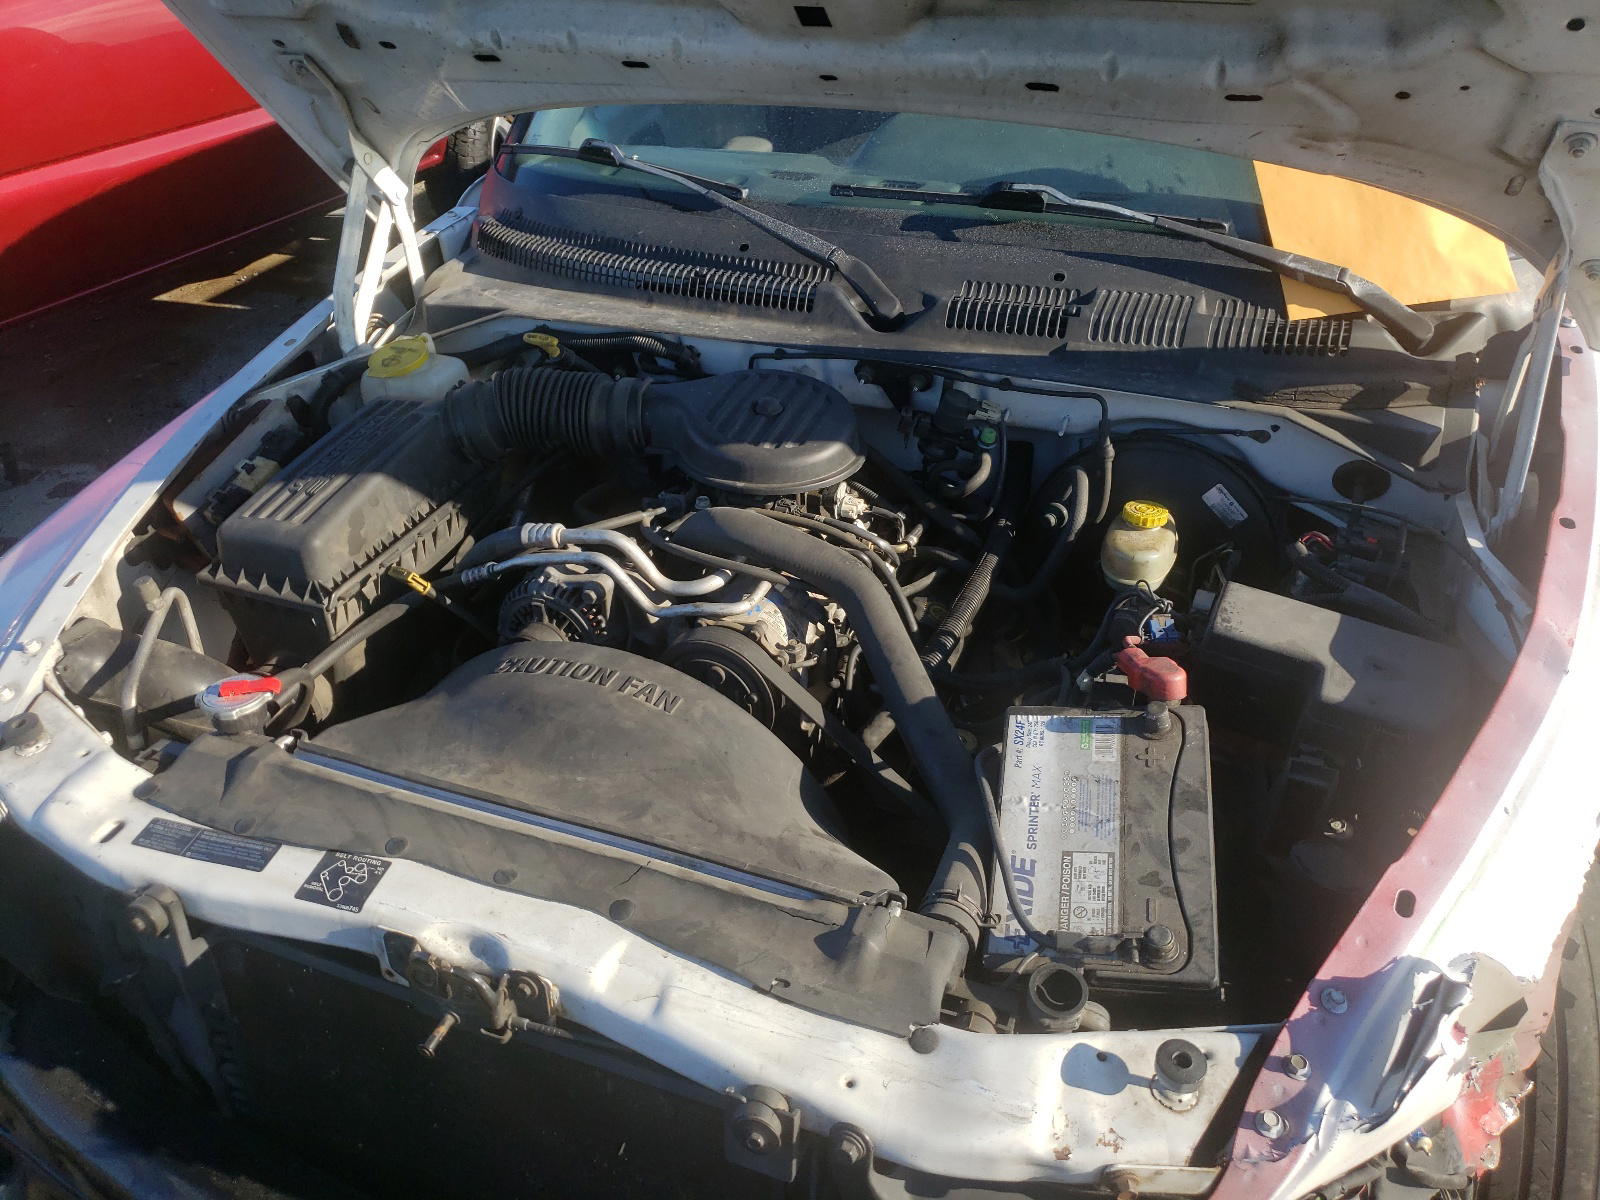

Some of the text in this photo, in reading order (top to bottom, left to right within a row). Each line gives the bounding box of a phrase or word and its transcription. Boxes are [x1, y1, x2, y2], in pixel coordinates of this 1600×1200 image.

[496, 655, 684, 715] CAUTION FAN
[1013, 718, 1026, 746] SX24F
[1014, 755, 1023, 769] Part
[1026, 765, 1042, 850] SPRINTER MAX
[335, 852, 382, 866] BELT ROUTING
[1061, 855, 1073, 890] POISON
[1059, 894, 1072, 932] ANGER
